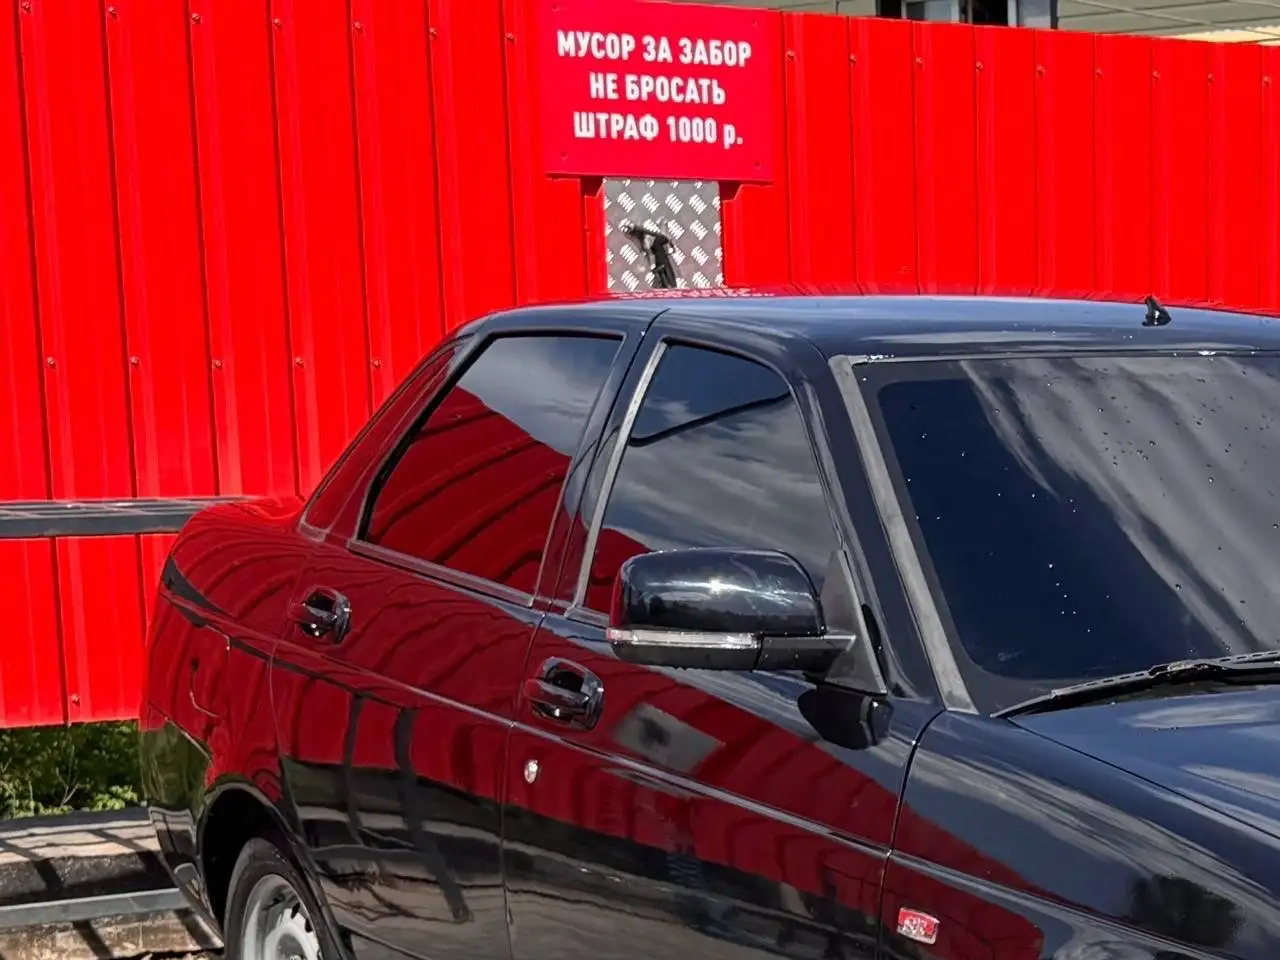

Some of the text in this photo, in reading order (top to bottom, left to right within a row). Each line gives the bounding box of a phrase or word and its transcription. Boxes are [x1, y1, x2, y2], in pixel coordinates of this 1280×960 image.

[557, 29, 752, 67] МУСОР ЗА ЗАБОР
[589, 71, 726, 105] НЕ БРОСАТЬ
[573, 111, 659, 141] ШТРАФ
[667, 116, 718, 144] 1000
